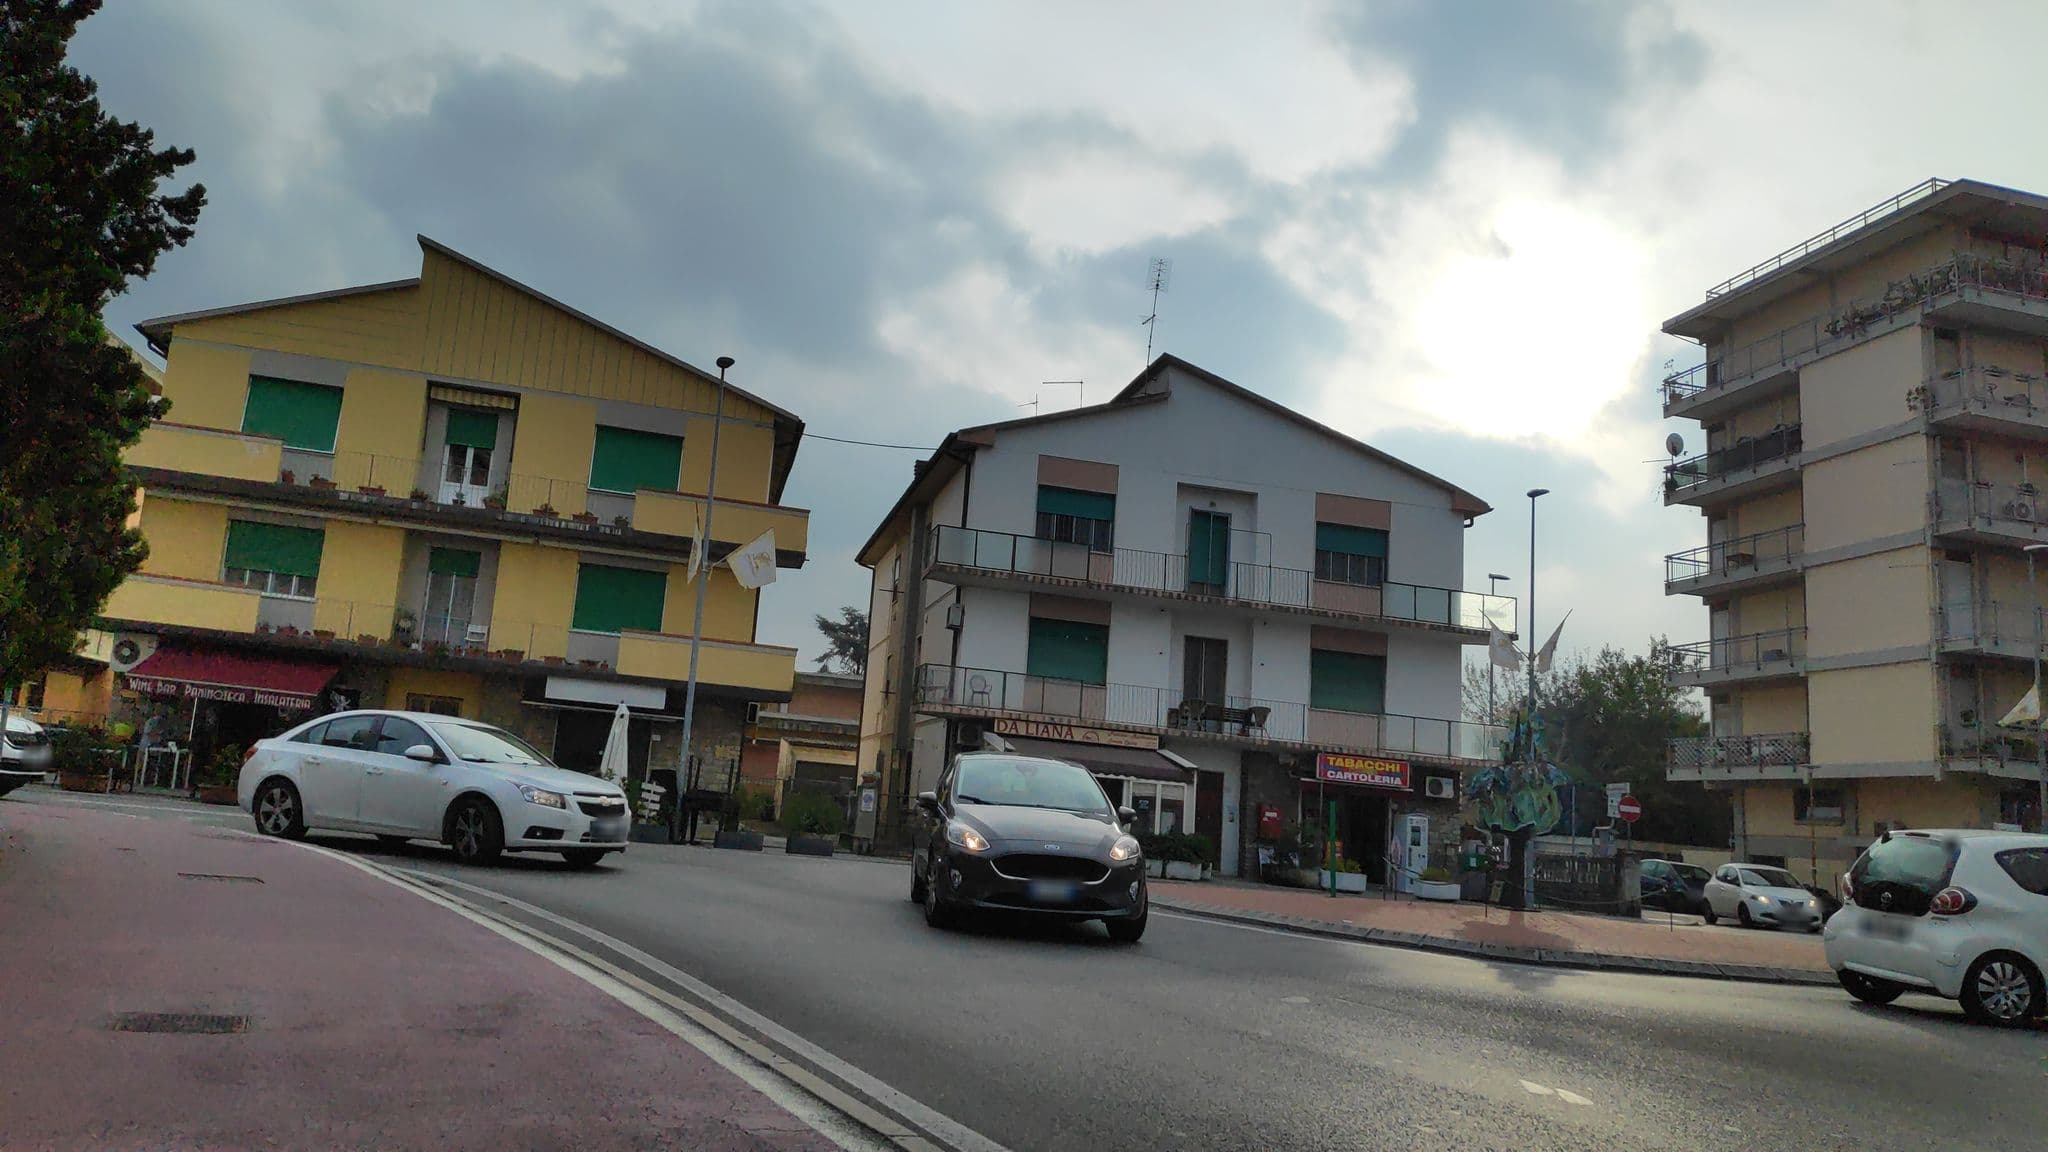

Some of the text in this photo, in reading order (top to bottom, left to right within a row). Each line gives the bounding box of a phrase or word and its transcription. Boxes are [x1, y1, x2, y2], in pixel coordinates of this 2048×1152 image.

[157, 681, 177, 695] BAR
[997, 719, 1074, 739] DA LIANA
[1327, 756, 1401, 772] TABACCHI
[1327, 770, 1402, 785] CARTOLERIA
